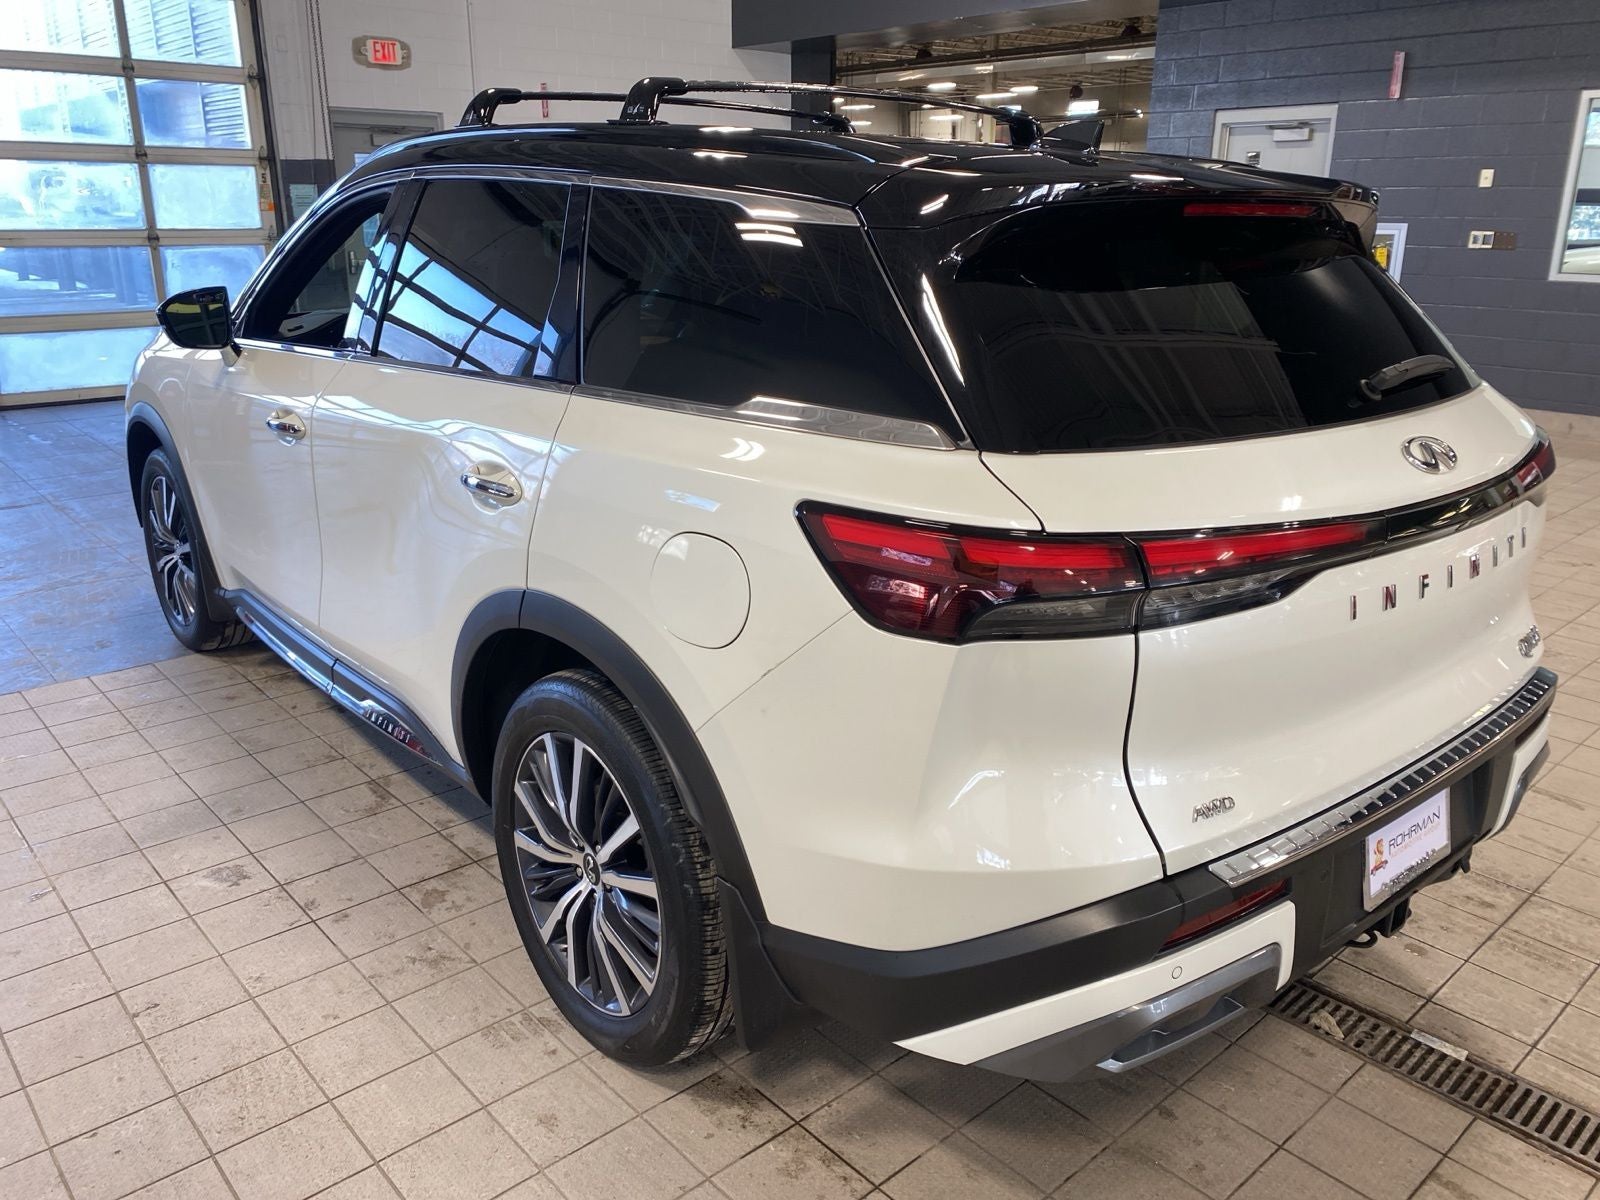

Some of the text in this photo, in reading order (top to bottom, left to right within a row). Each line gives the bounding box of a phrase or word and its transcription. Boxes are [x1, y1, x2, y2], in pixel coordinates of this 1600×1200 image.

[372, 40, 397, 62] EXIT
[1349, 526, 1527, 621] INFINITI
[1191, 796, 1236, 823] AWD
[1388, 805, 1441, 857] ROHRMAN
